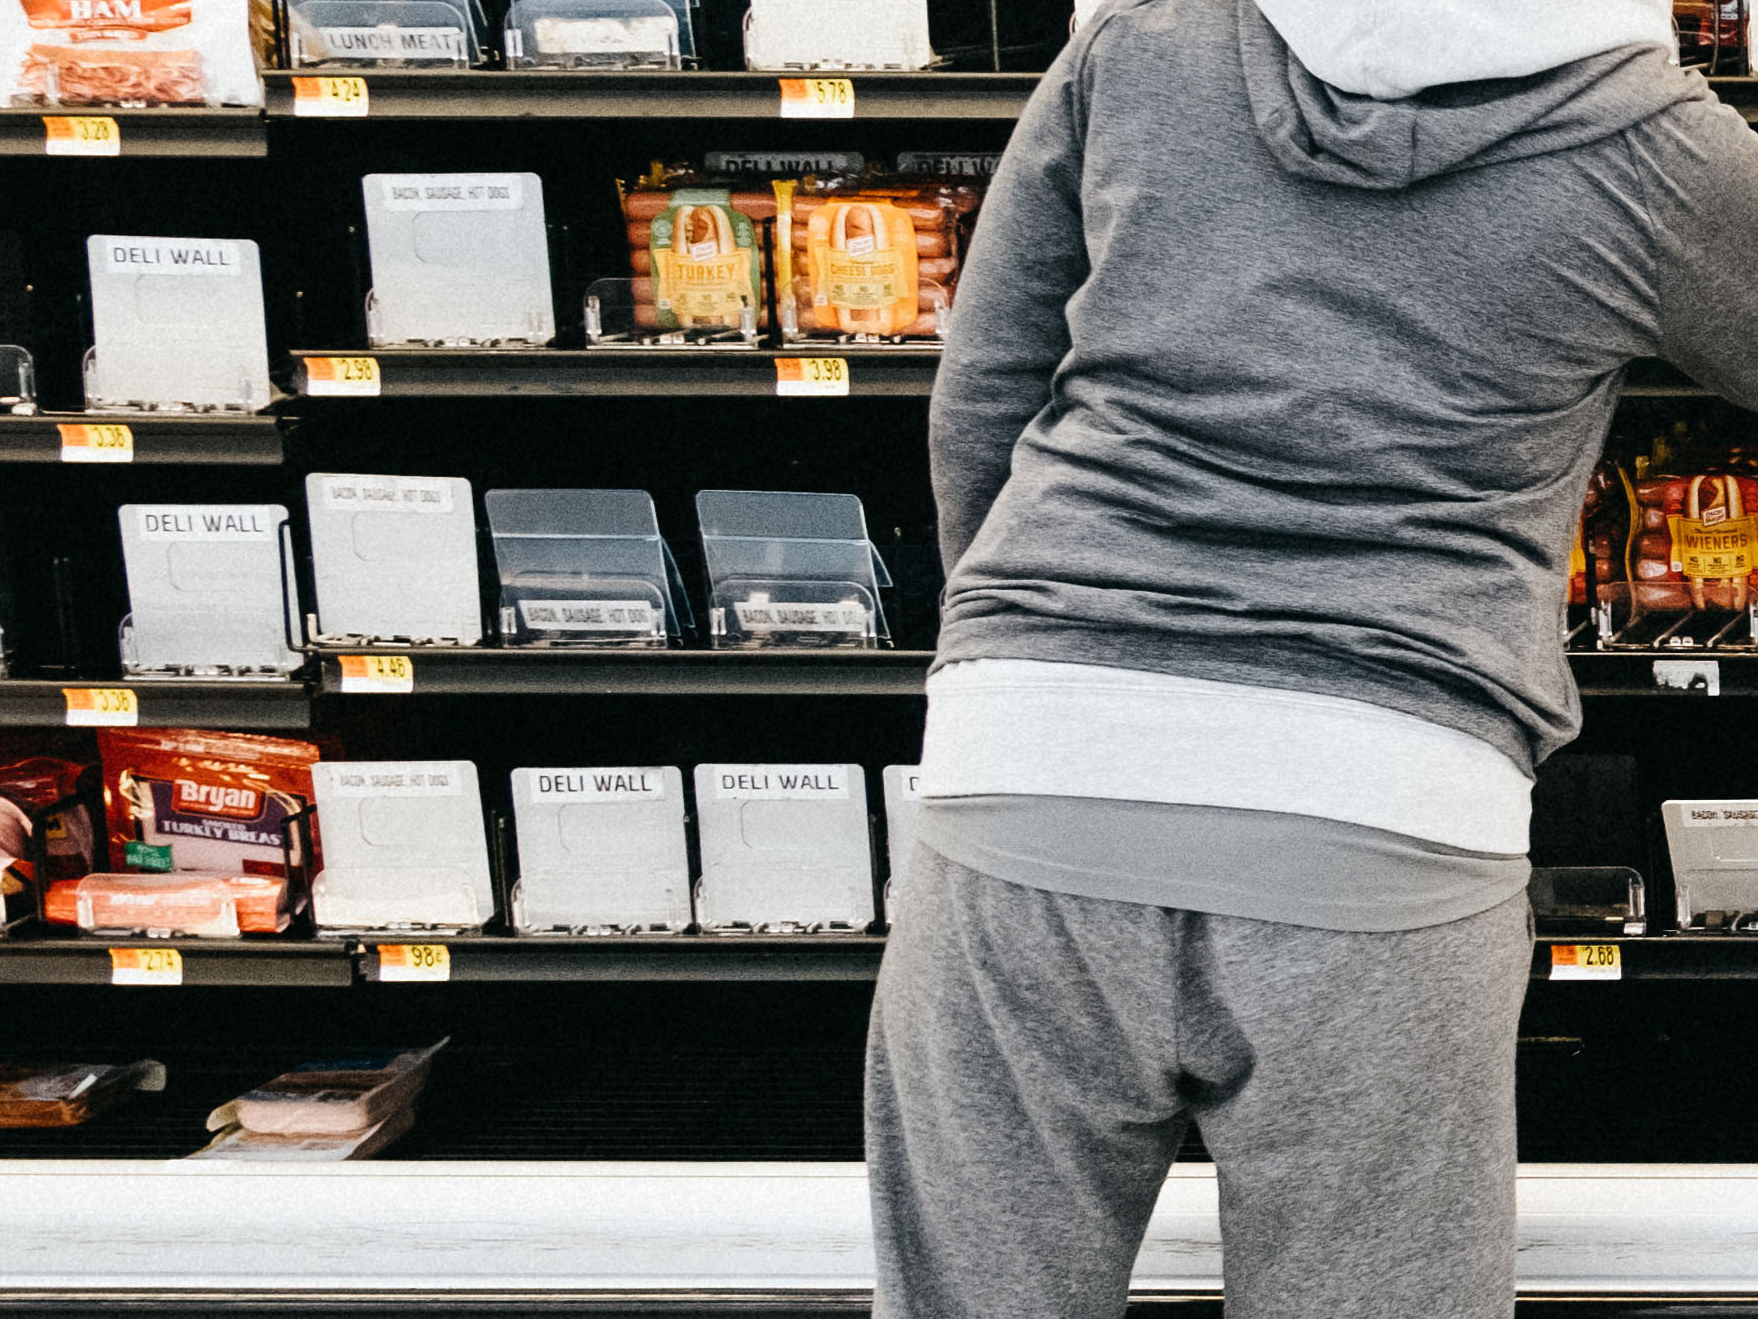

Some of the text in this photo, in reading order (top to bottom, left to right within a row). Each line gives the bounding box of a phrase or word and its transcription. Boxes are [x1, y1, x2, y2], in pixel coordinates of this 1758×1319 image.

[70, 0, 142, 18] HAM
[329, 32, 452, 51] LUNCH MEAT
[112, 246, 231, 267] DELI WALL
[677, 264, 735, 280] TURKEY
[831, 264, 895, 276] CHEESE DOGS
[144, 513, 264, 534] DELI WALL
[1684, 533, 1748, 551] WIENERS
[538, 773, 656, 794] DELI WALL
[721, 774, 840, 791] DELI WALL
[176, 779, 255, 811] Bryan
[161, 820, 284, 845] TURKEY BREAS
